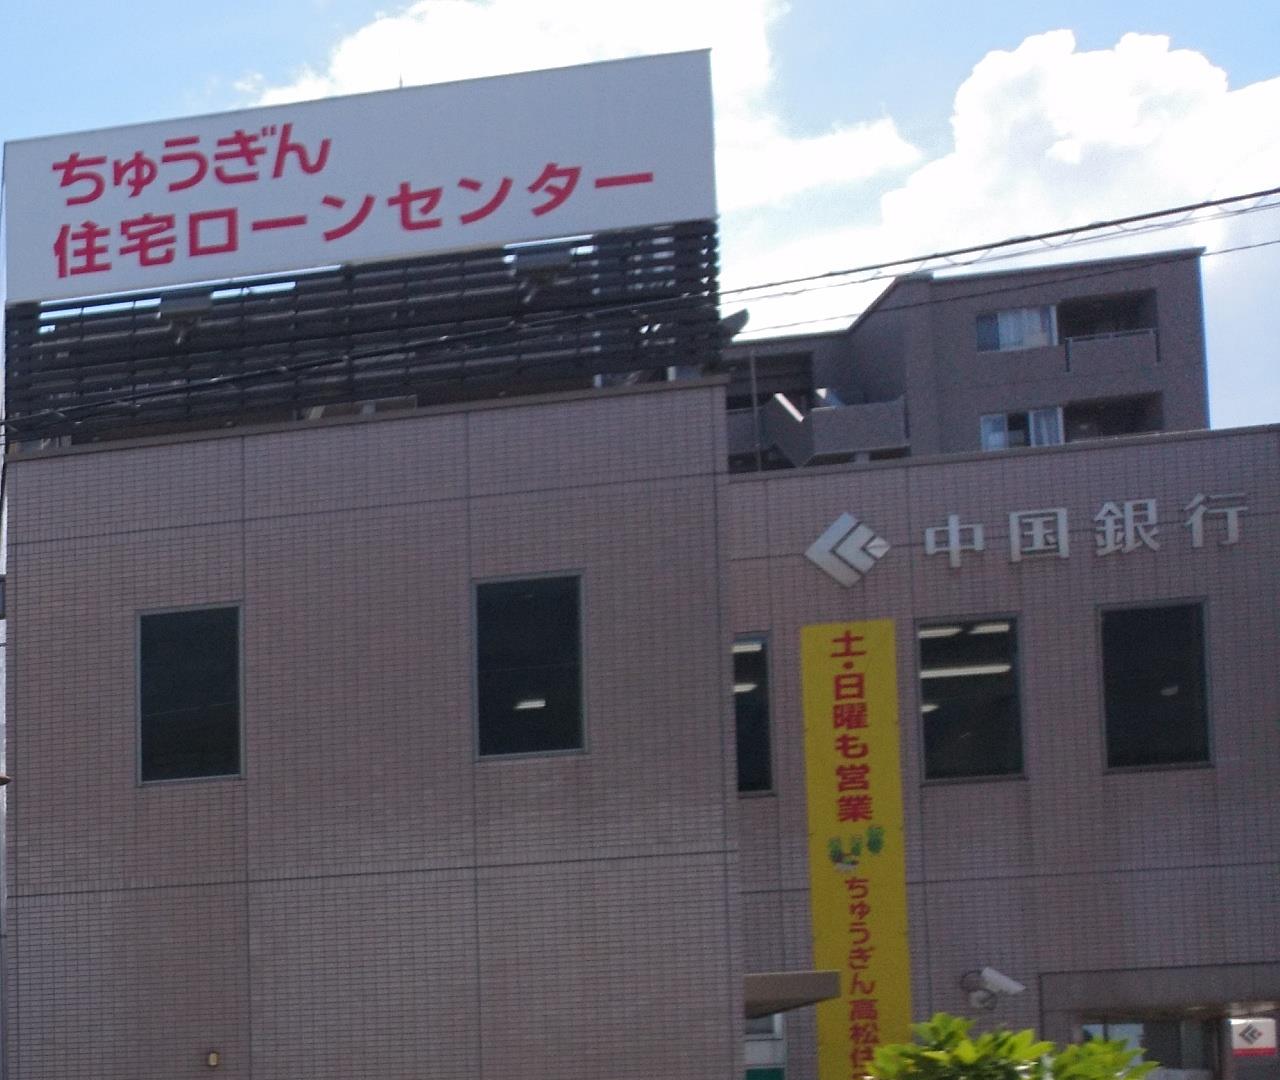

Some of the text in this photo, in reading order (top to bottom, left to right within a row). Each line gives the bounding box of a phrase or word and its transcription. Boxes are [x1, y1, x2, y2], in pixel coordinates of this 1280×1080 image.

[52, 122, 333, 206] ちゅうぎん
[52, 163, 654, 279] 住宅ローンセンター
[925, 493, 1248, 567] 中国銀行
[830, 630, 874, 822] 土・日曜も営業
